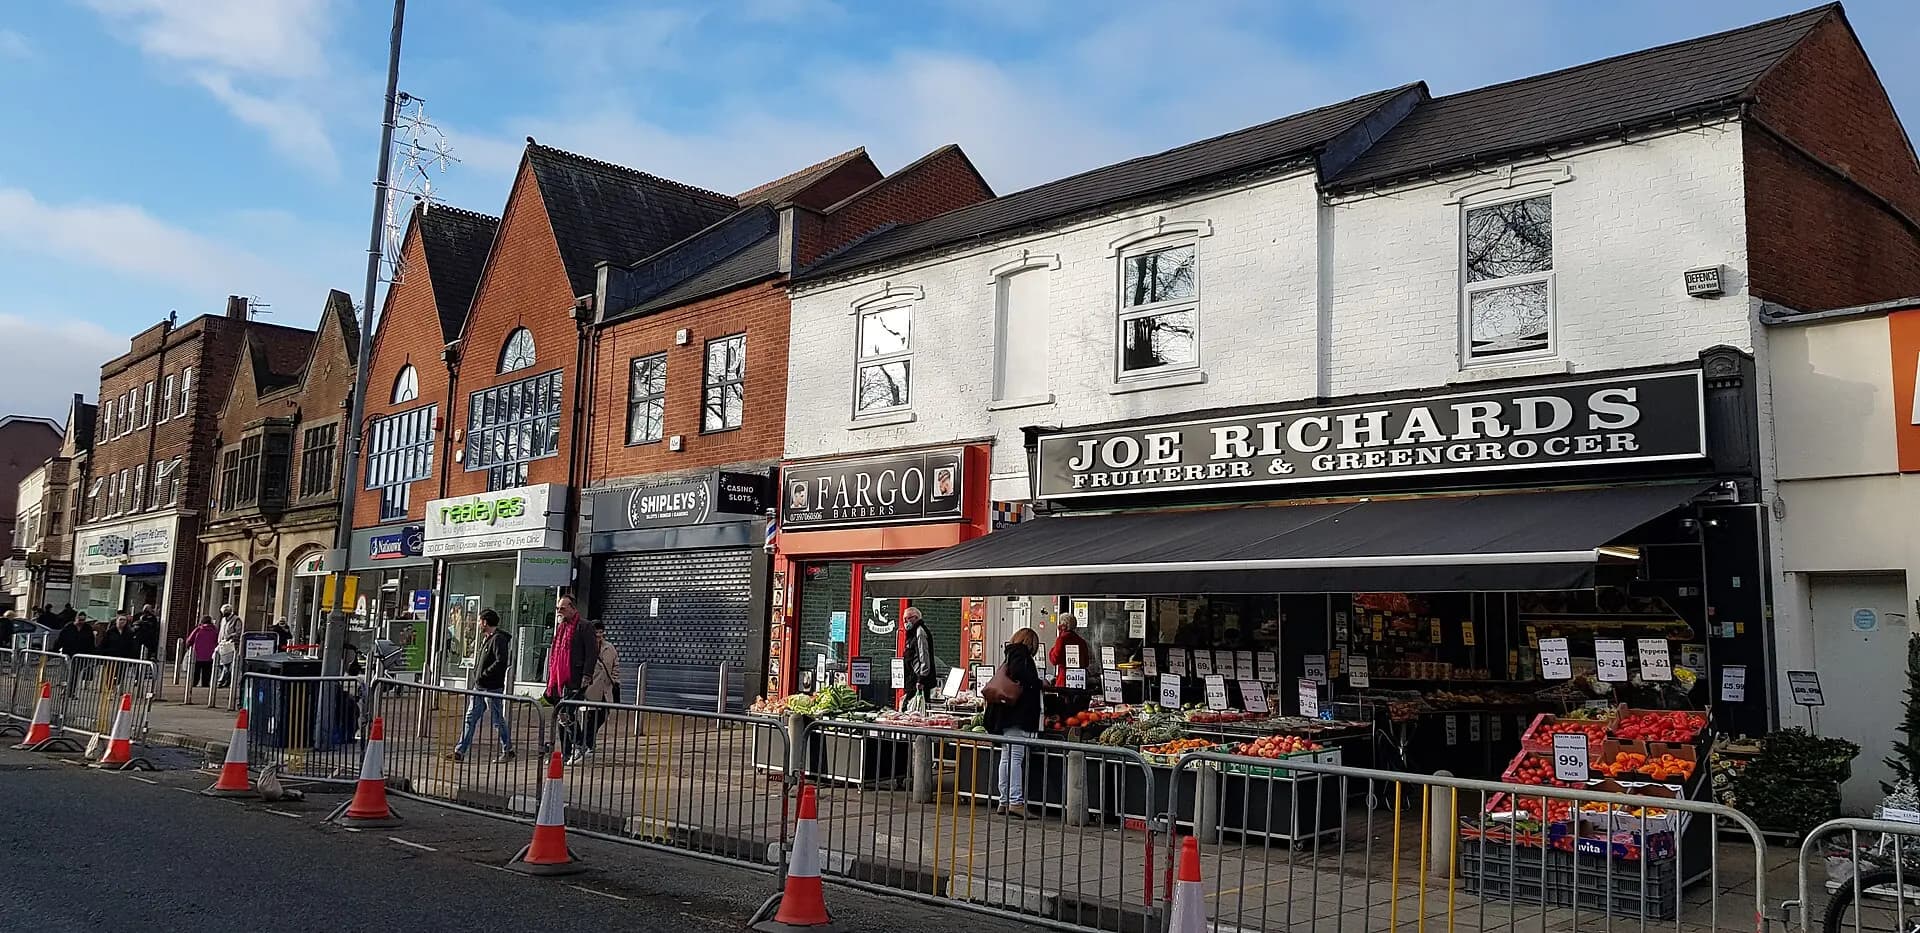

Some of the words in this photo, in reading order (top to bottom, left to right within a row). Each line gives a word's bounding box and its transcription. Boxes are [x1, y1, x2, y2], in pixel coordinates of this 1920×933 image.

[1687, 271, 1717, 283] DEFENCE
[1069, 432, 1182, 471] JOE
[1210, 387, 1640, 460] RICHARDS
[1073, 461, 1252, 489] FRUITERER
[1268, 458, 1294, 476] &
[1311, 432, 1640, 471] GREENGROCER
[727, 484, 754, 493] CASINO
[815, 467, 924, 511] FARGO
[640, 491, 696, 513] SHIPLEYS
[728, 493, 751, 501] SLOTS
[440, 496, 525, 526] realeyes
[833, 505, 894, 519] BARBERS
[479, 539, 501, 548] Screening
[527, 535, 540, 543] Clinic
[523, 556, 569, 565] realeyes
[1640, 648, 1668, 656] Peppers
[1306, 668, 1324, 677] 99p
[1722, 682, 1745, 690] £5.99
[1162, 688, 1179, 700] 69p
[1559, 754, 1584, 768] 99p
